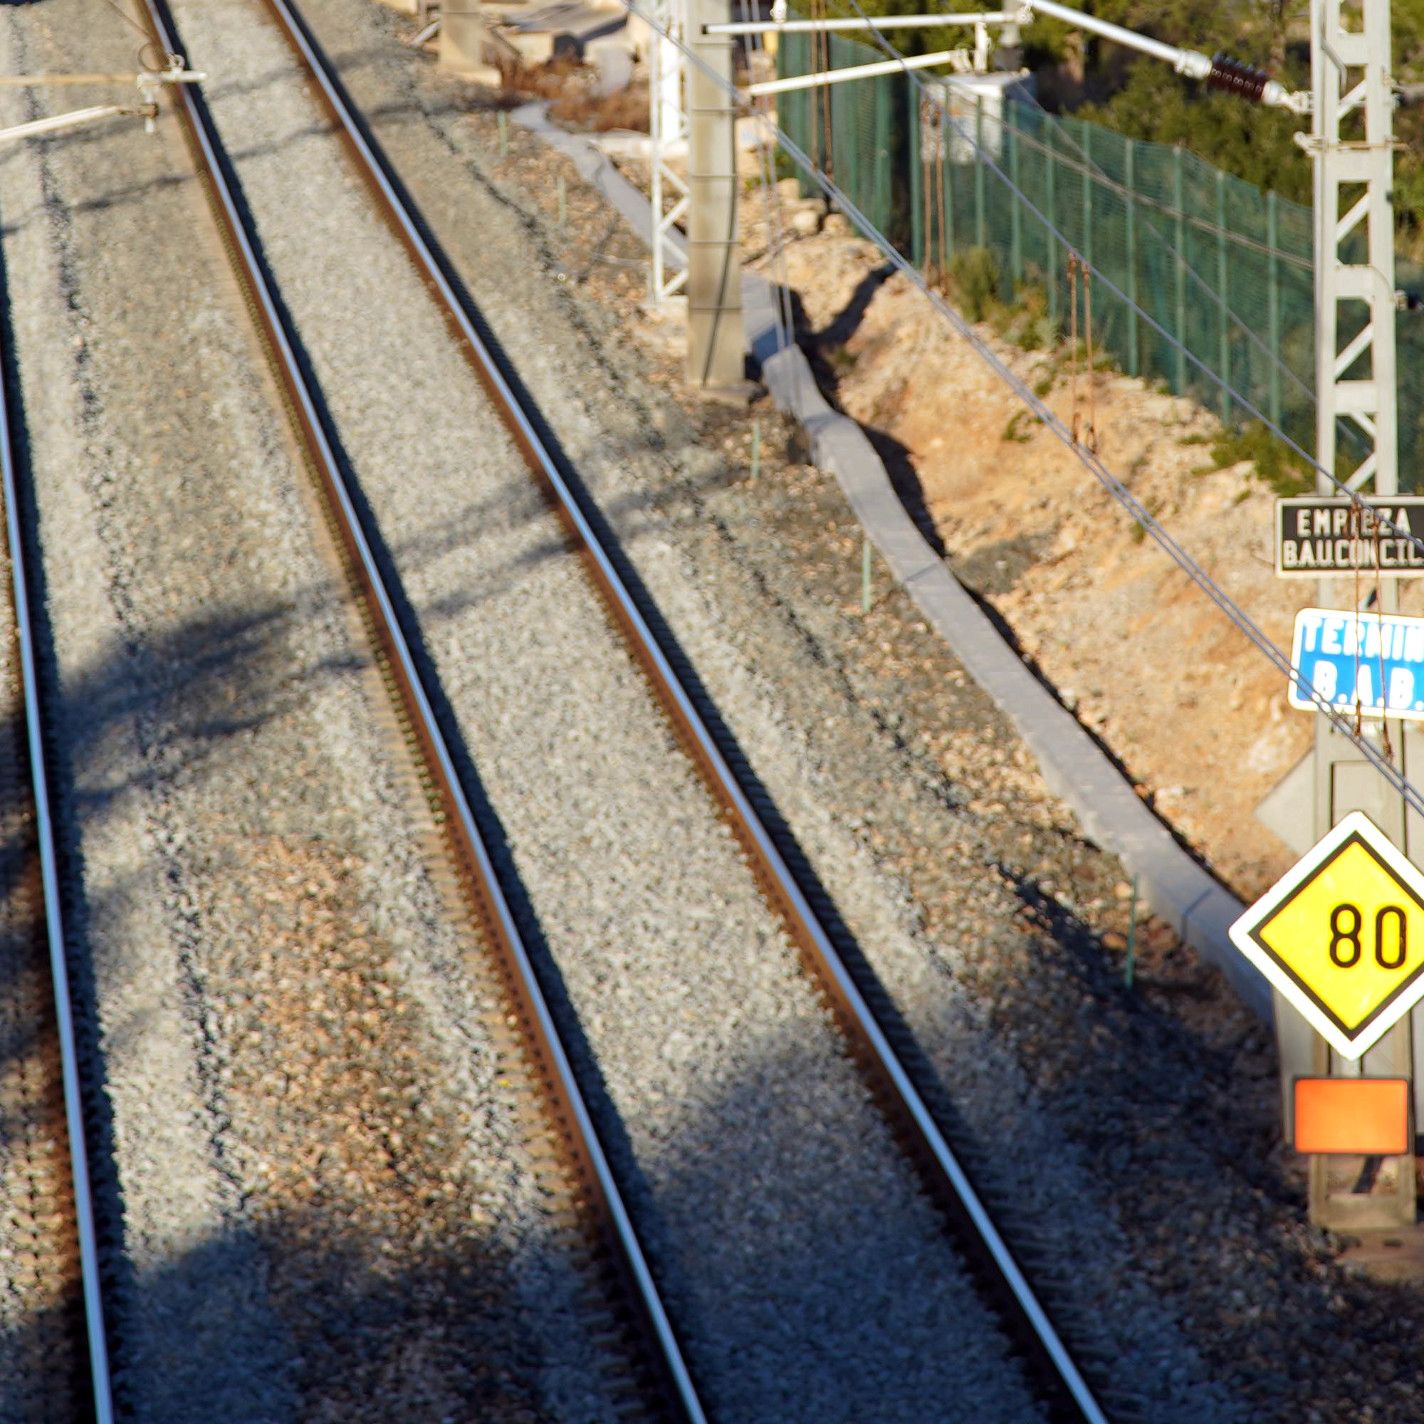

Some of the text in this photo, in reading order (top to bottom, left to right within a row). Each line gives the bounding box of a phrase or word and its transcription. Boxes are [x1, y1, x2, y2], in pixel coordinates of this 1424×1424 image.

[1296, 508, 1411, 537] EMPIEZA
[1312, 660, 1424, 712] B.A.B.
[1329, 903, 1407, 969] 80
